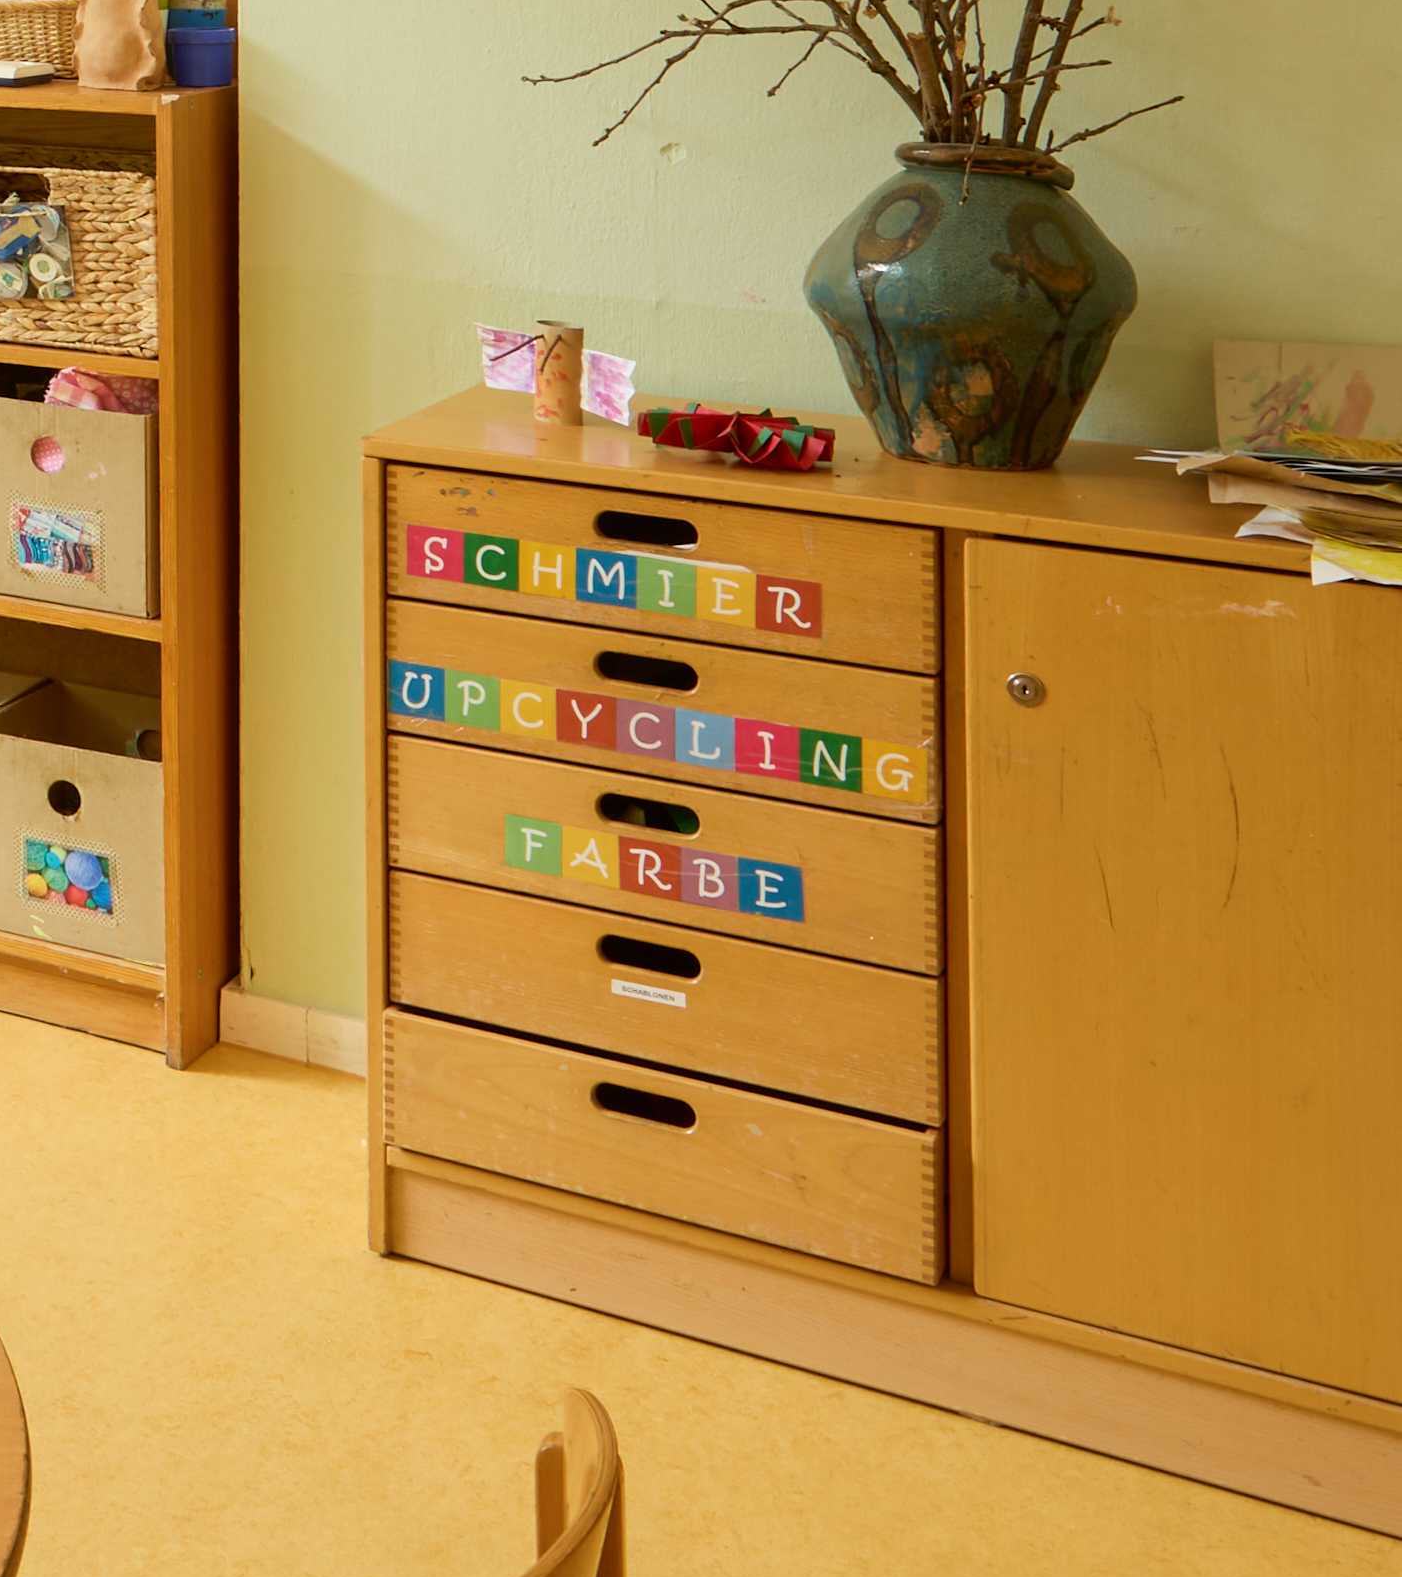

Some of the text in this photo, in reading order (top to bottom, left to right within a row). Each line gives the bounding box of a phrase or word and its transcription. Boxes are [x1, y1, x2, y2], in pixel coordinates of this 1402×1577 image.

[423, 536, 811, 629] SCHMIER
[401, 671, 914, 792] UPCYCLING
[520, 827, 787, 909] FARBE
